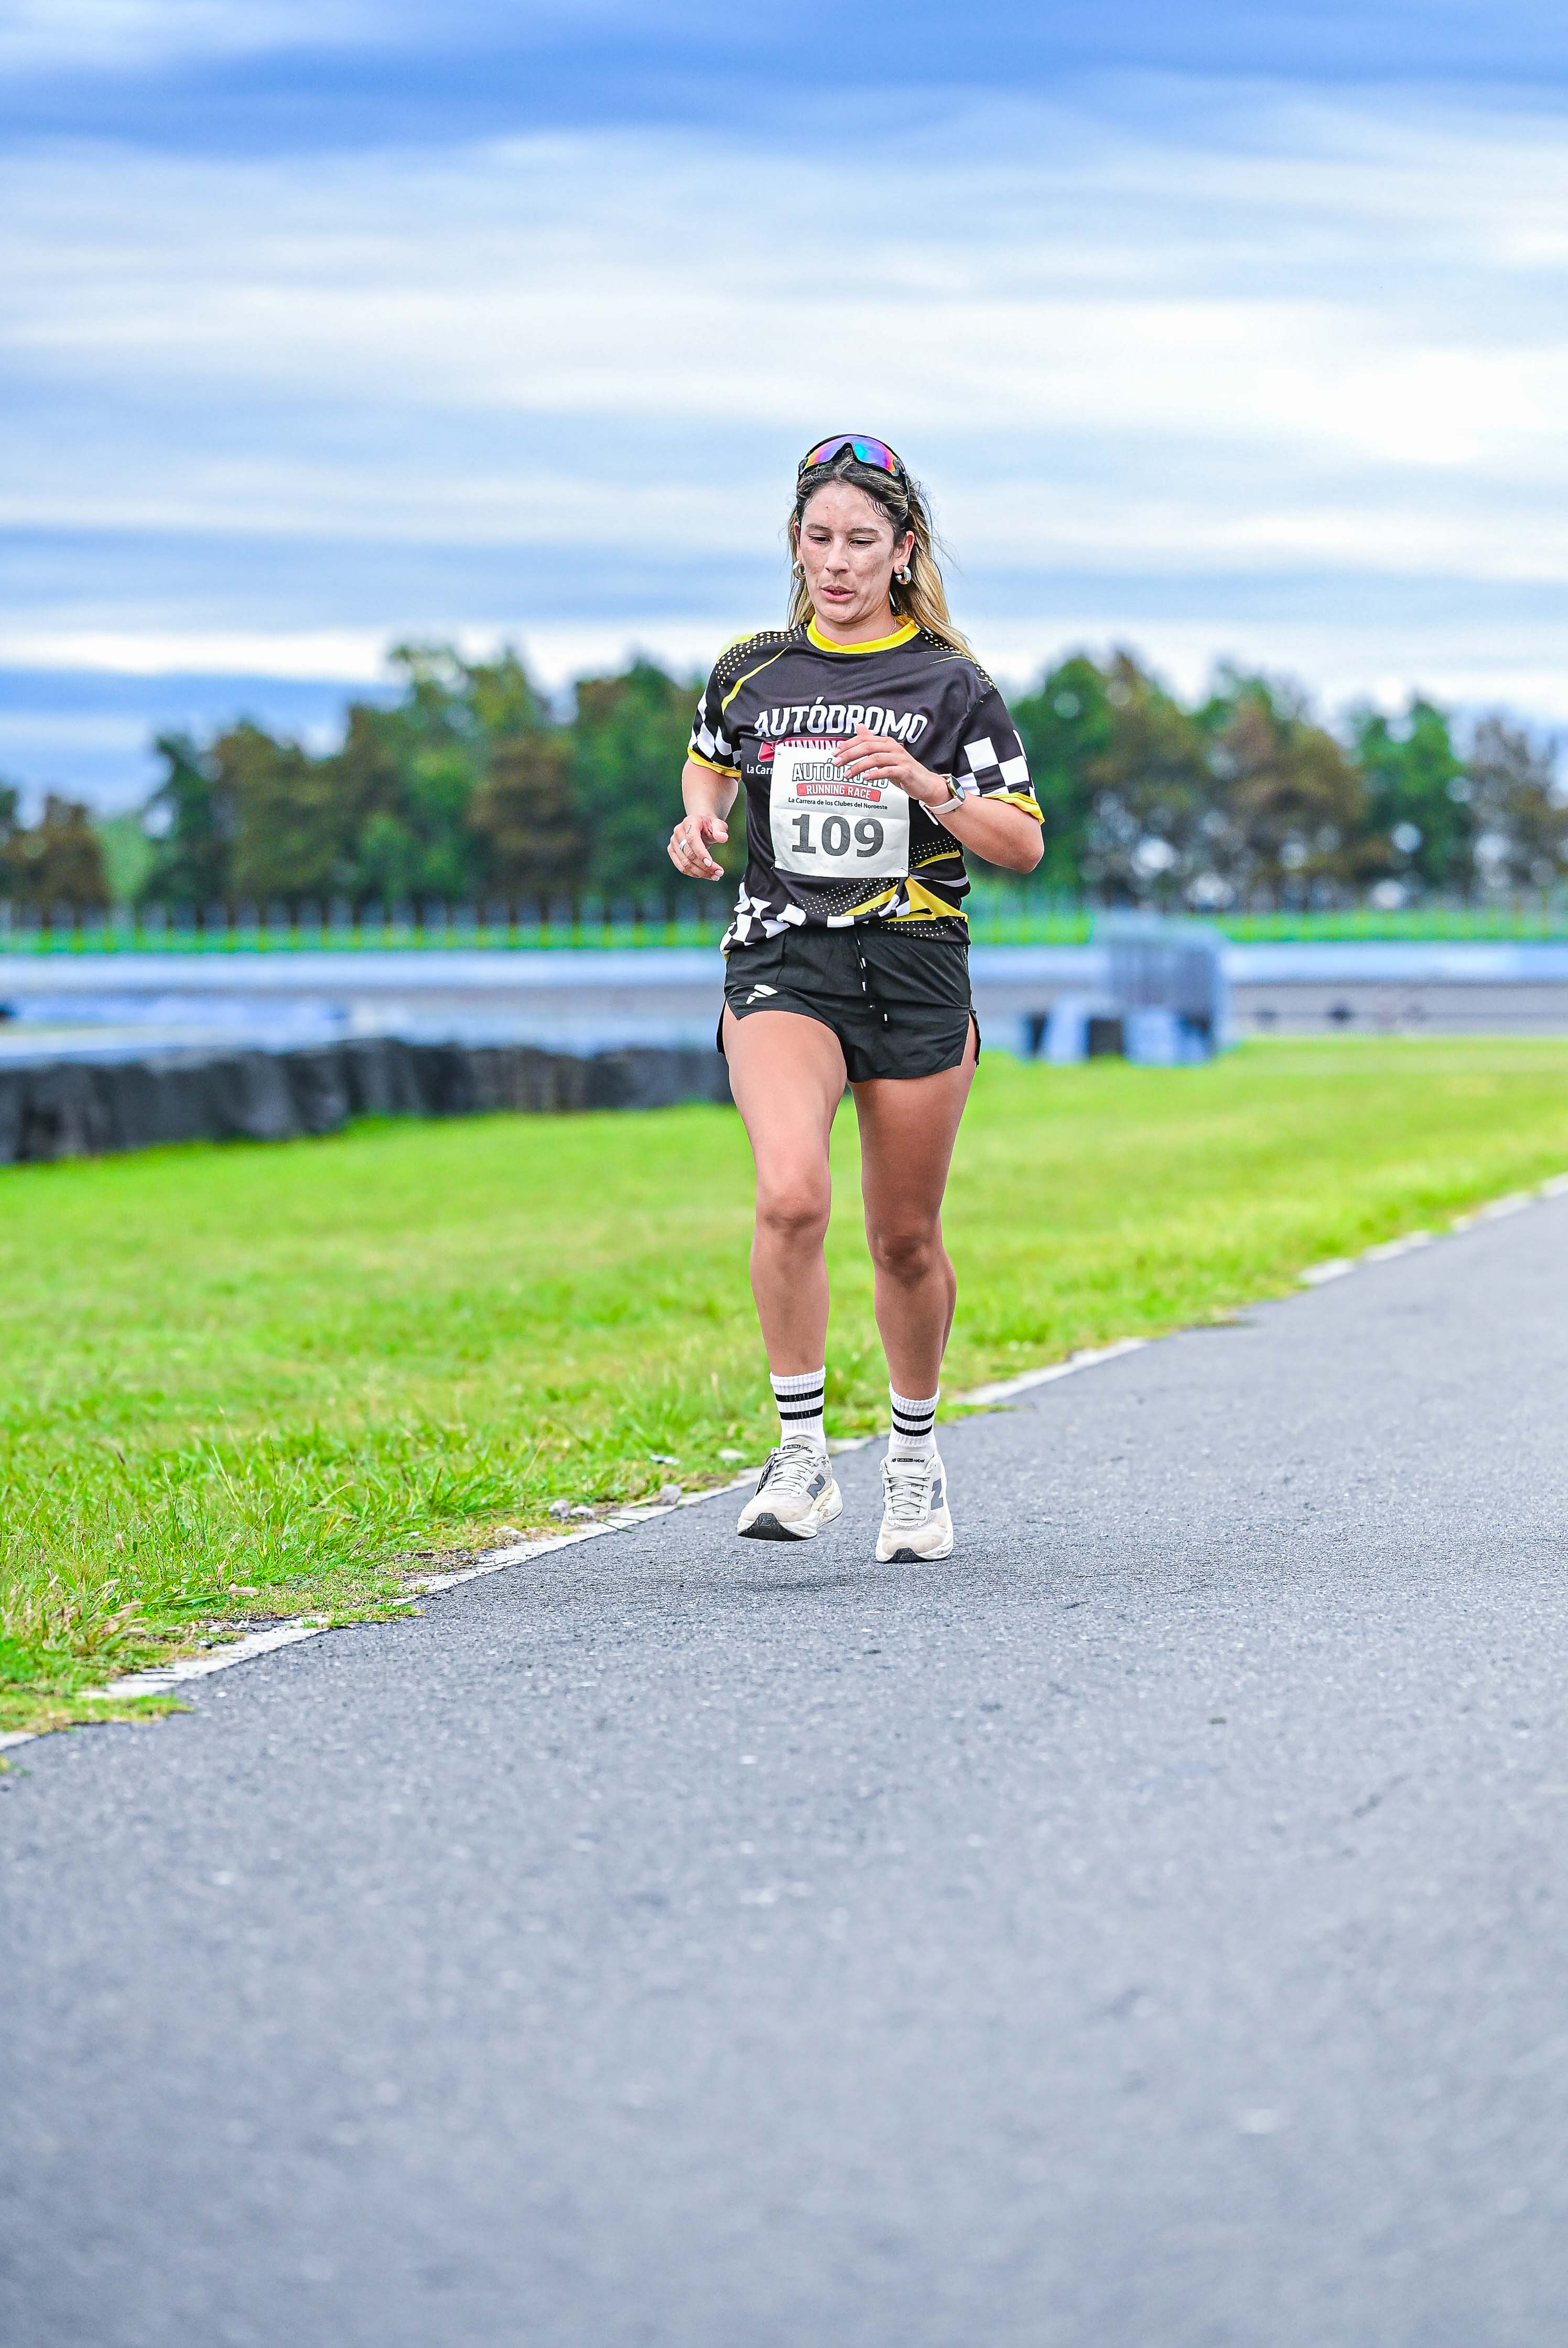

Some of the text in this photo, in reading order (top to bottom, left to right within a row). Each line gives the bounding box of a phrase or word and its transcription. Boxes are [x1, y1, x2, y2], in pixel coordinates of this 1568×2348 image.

[754, 696, 928, 744] AUTÓDROMO
[747, 763, 773, 775] La Carr
[806, 784, 872, 800] RUNNING RACE
[792, 814, 884, 857] 109
